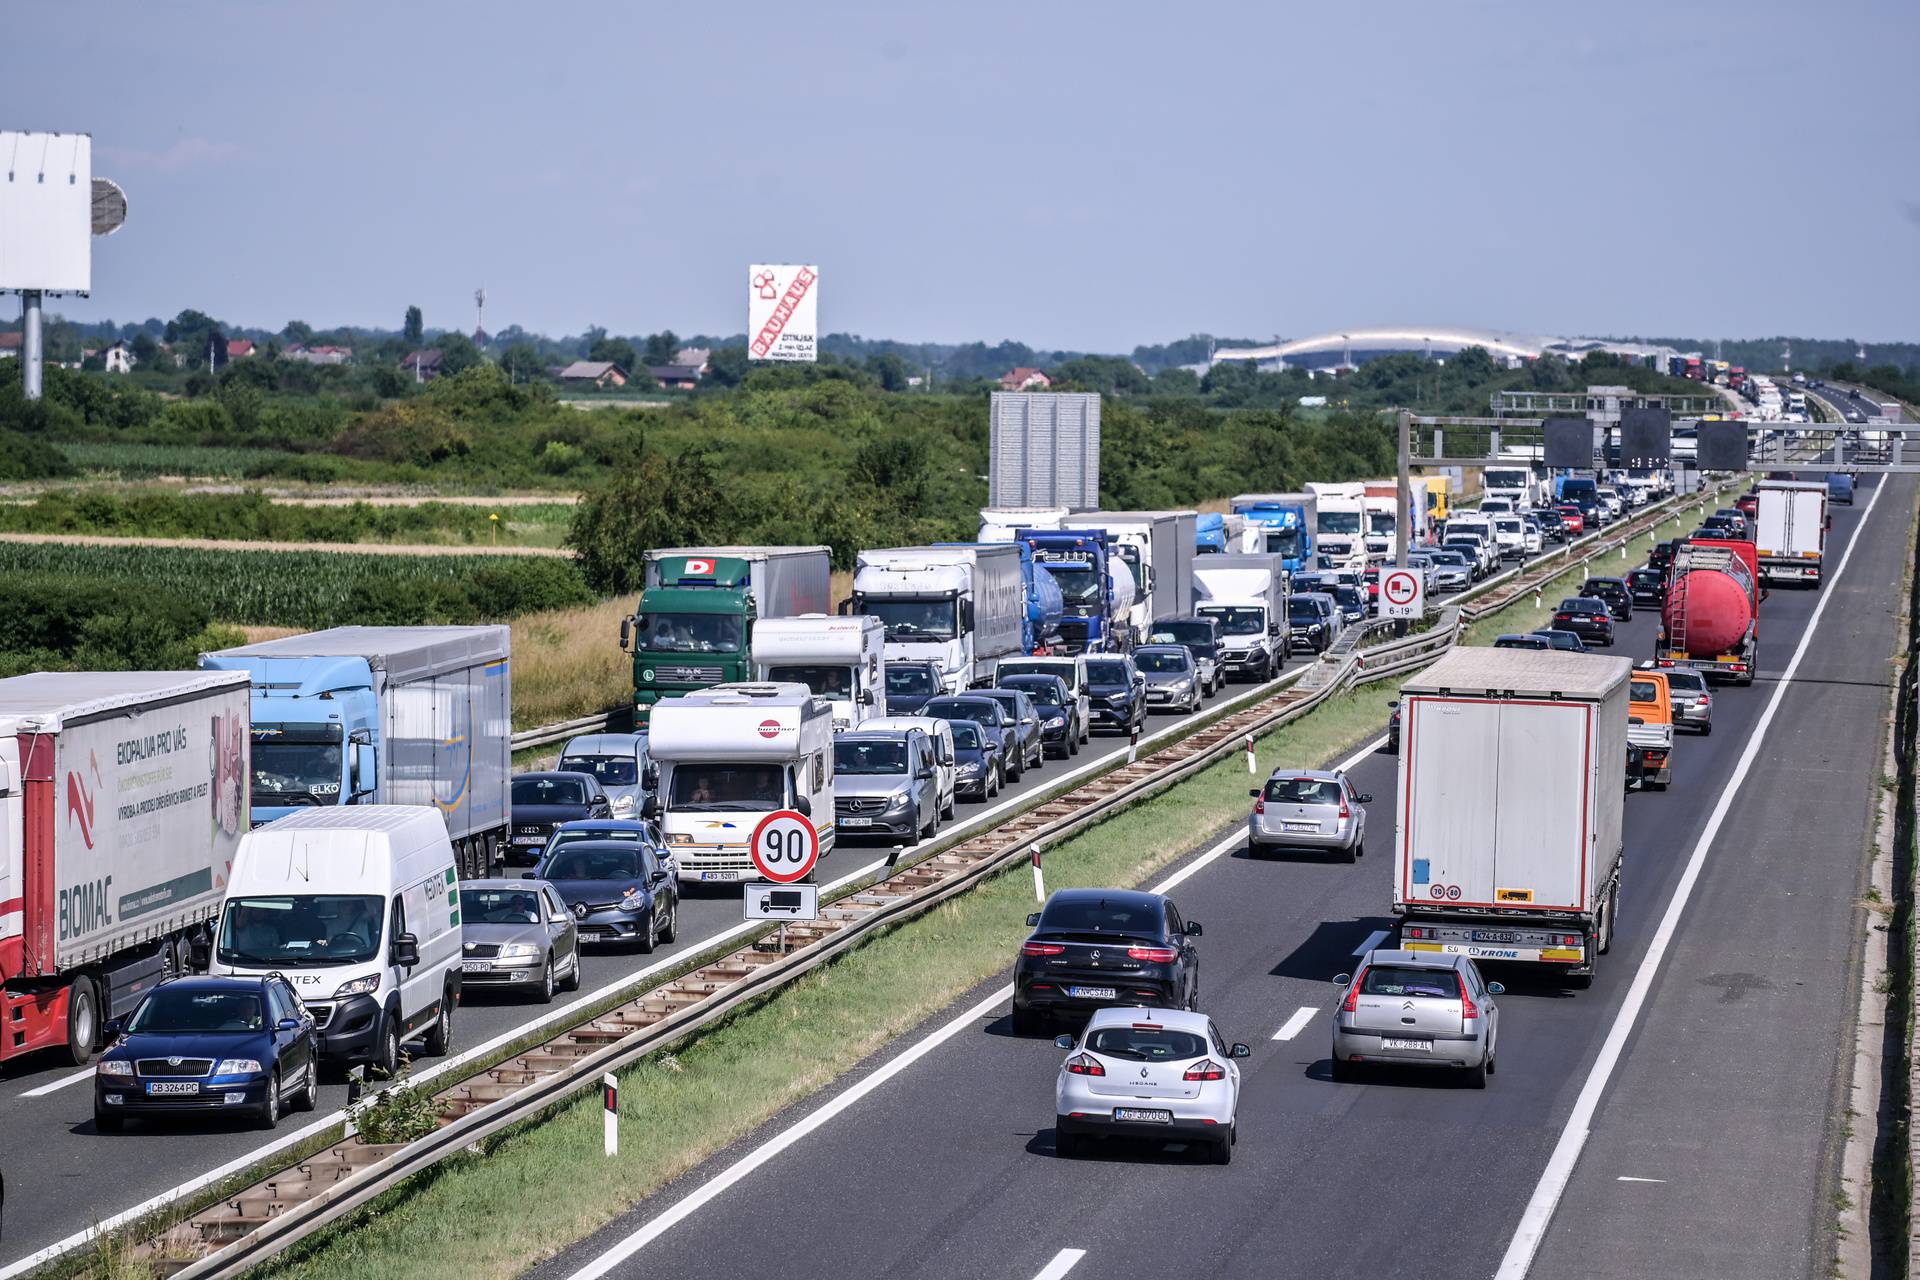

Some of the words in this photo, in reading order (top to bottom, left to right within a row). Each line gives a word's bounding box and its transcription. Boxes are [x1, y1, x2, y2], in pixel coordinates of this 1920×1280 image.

[752, 267, 815, 355] BAUHAUS
[118, 736, 155, 765] EKOPALIVA
[157, 730, 171, 756] PRO
[173, 724, 186, 751] VÁS
[311, 783, 339, 794] ELKO
[118, 802, 135, 820] VÝROBA
[140, 797, 155, 815] PRODEJ
[766, 829, 803, 863] 90
[60, 875, 112, 941] BIOMAC
[1481, 949, 1518, 958] KRONE
[290, 975, 322, 984] ITEX
[165, 1083, 184, 1092] 3264
